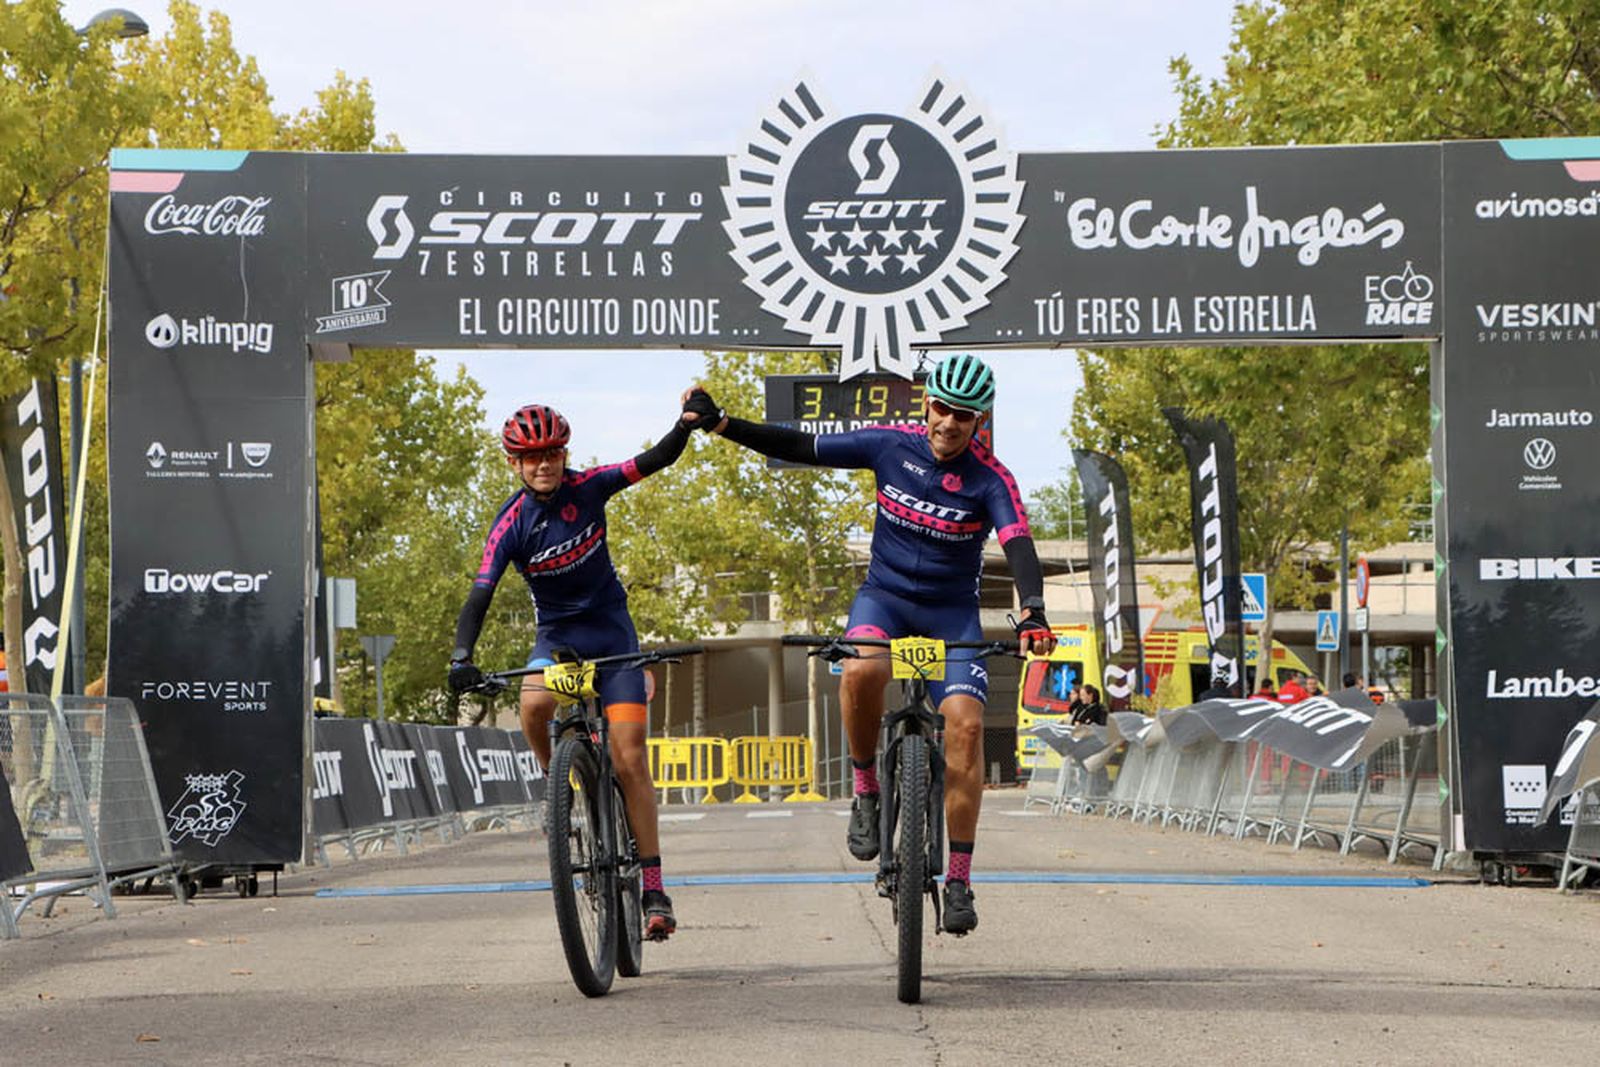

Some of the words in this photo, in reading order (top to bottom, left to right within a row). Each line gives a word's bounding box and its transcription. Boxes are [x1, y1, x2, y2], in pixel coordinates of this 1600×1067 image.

[440, 191, 704, 207] CIRCUITO
[802, 199, 948, 220] SCOTT
[418, 212, 704, 246] SCOTT
[1067, 198, 1117, 249] El
[1119, 200, 1232, 249] Corte
[1238, 186, 1405, 268] Inglés
[1364, 274, 1434, 303] ECO
[325, 311, 381, 331] ANIVERSARIO
[458, 300, 487, 335] EL
[498, 298, 620, 336] CIRCUITO
[632, 299, 721, 336] DONDE
[1034, 290, 1065, 336] TÚ
[1076, 296, 1141, 335] ERES
[1152, 296, 1182, 335] LA
[1194, 294, 1317, 333] ESTRELLA
[1365, 302, 1434, 325] RACE
[1475, 303, 1594, 328] VESKIN
[1477, 329, 1599, 343] SPORTSWEAR
[1485, 408, 1593, 428] Jarmauto
[170, 450, 219, 459] RENAULT
[882, 484, 973, 521] SCOTT
[529, 521, 596, 565] SCOTT
[144, 568, 269, 593] TowCar
[899, 646, 937, 663] 1103
[142, 681, 272, 700] FOREVENT
[223, 702, 267, 711] SPORTS
